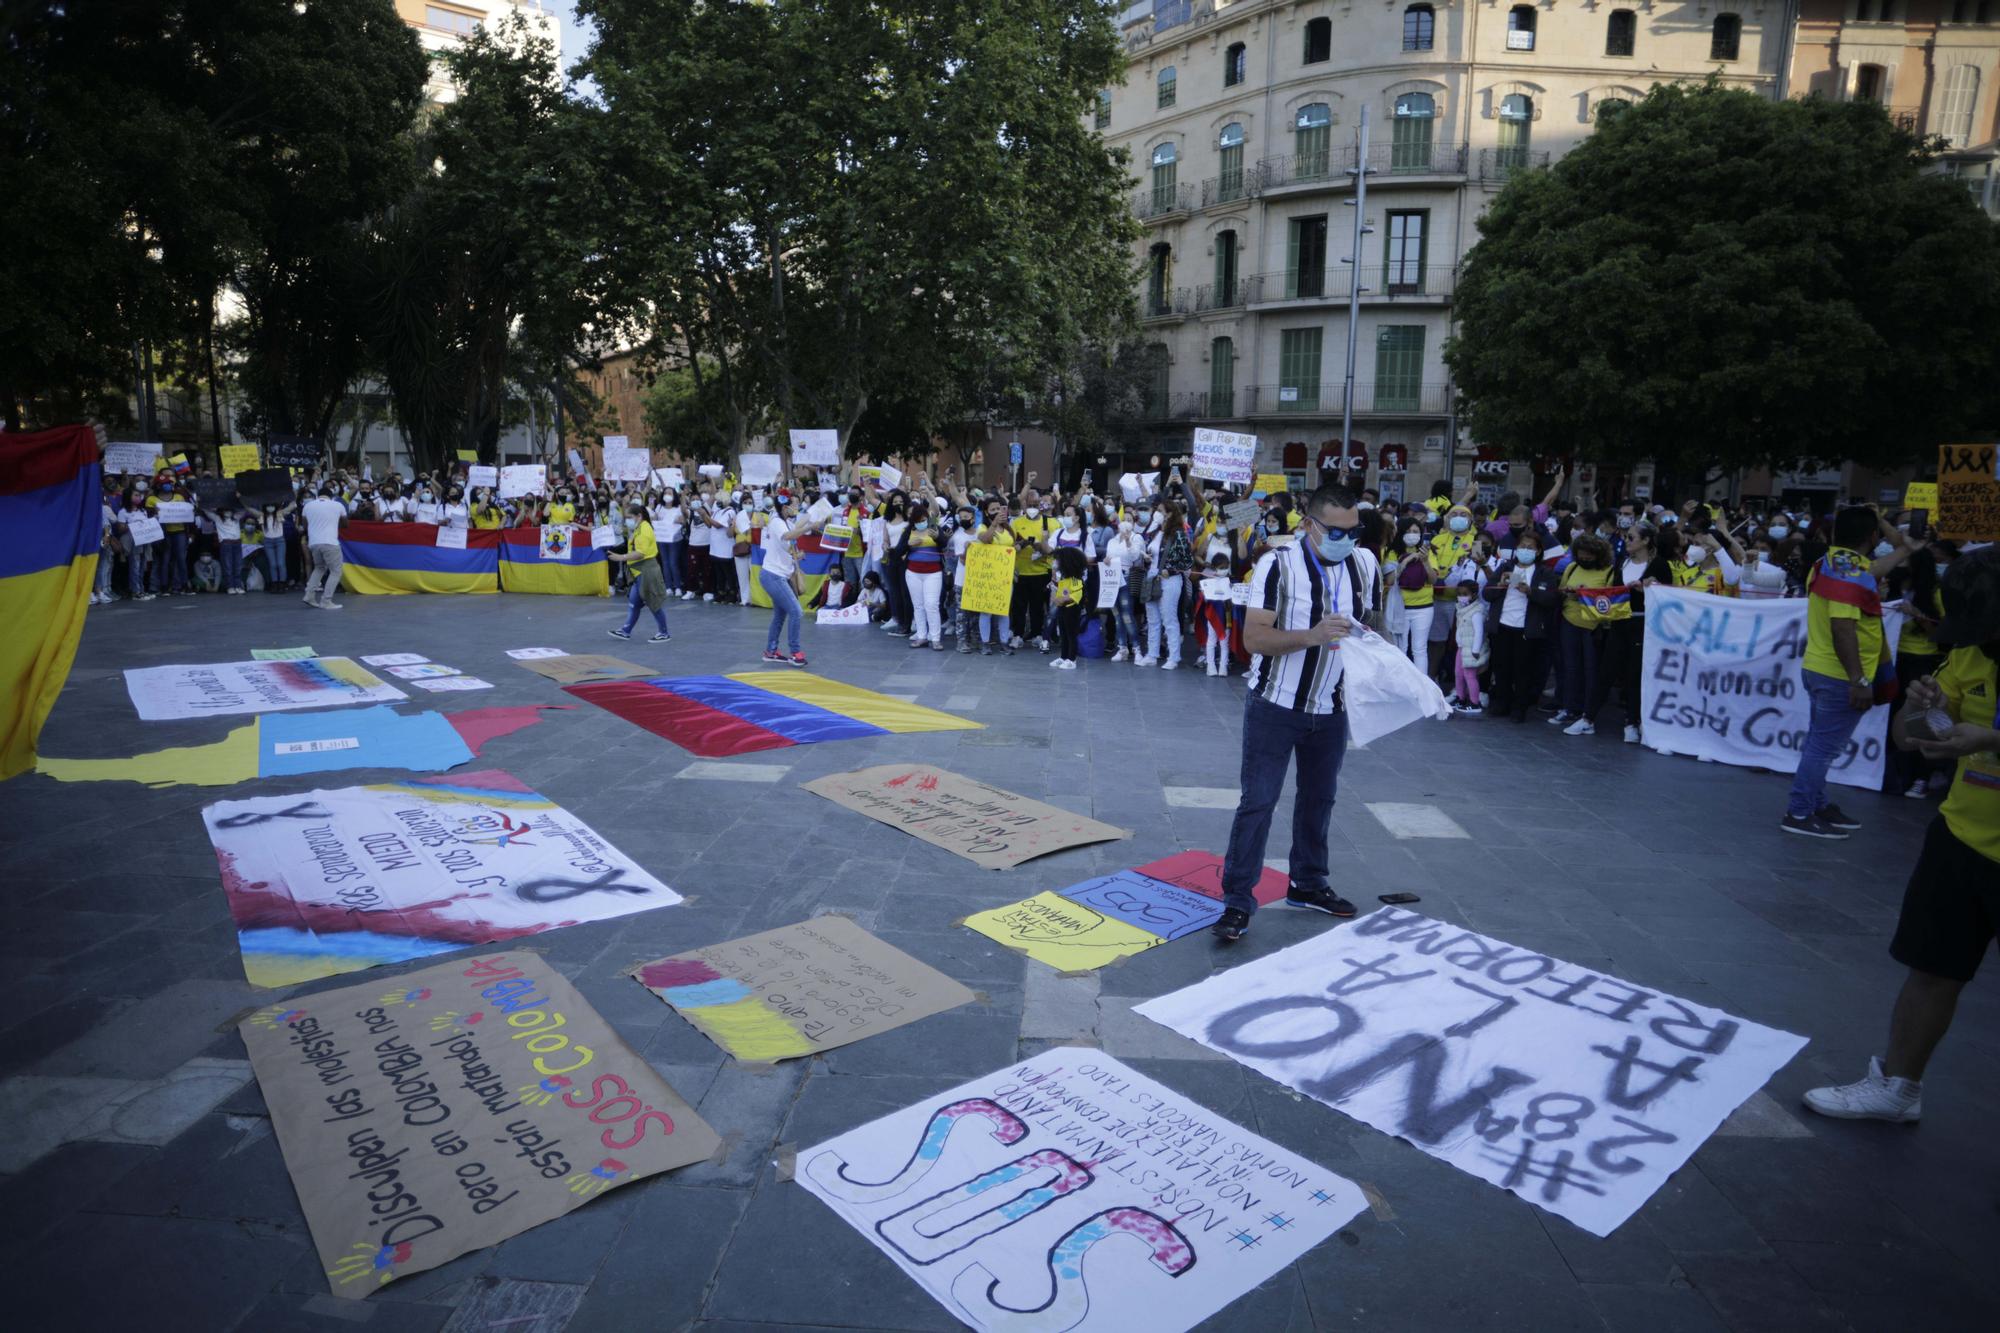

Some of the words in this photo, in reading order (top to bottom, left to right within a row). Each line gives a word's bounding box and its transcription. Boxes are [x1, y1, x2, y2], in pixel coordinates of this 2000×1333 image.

[1195, 444, 1224, 454] HUEVOS
[1474, 461, 1509, 473] KFC
[1651, 599, 1764, 658] CALI
[1654, 648, 1689, 685] El
[1697, 663, 1795, 700] mundo
[358, 831, 421, 872] MIEDO
[393, 806, 458, 851] salieron
[438, 848, 484, 884] nos
[991, 915, 1031, 937] NOS
[1005, 909, 1062, 935] ESTAN
[1021, 897, 1088, 931] MATANDO
[1085, 890, 1190, 924] SOS
[1323, 951, 1519, 1039] LA
[1350, 904, 1740, 1055] REFORMA
[354, 1005, 400, 1039] nos
[460, 955, 594, 1076] COLOMBIA
[766, 992, 808, 1019] amo
[286, 1016, 353, 1087] molestias
[428, 1030, 520, 1117] matando!
[1202, 994, 1540, 1146] NO
[1590, 1035, 1704, 1112] A
[322, 1085, 375, 1124] las
[374, 1035, 451, 1126] COLOMBIA
[428, 1128, 469, 1157] en
[501, 1118, 573, 1182] están
[344, 1126, 445, 1247] Disculpen
[803, 1096, 1197, 1333] SOS
